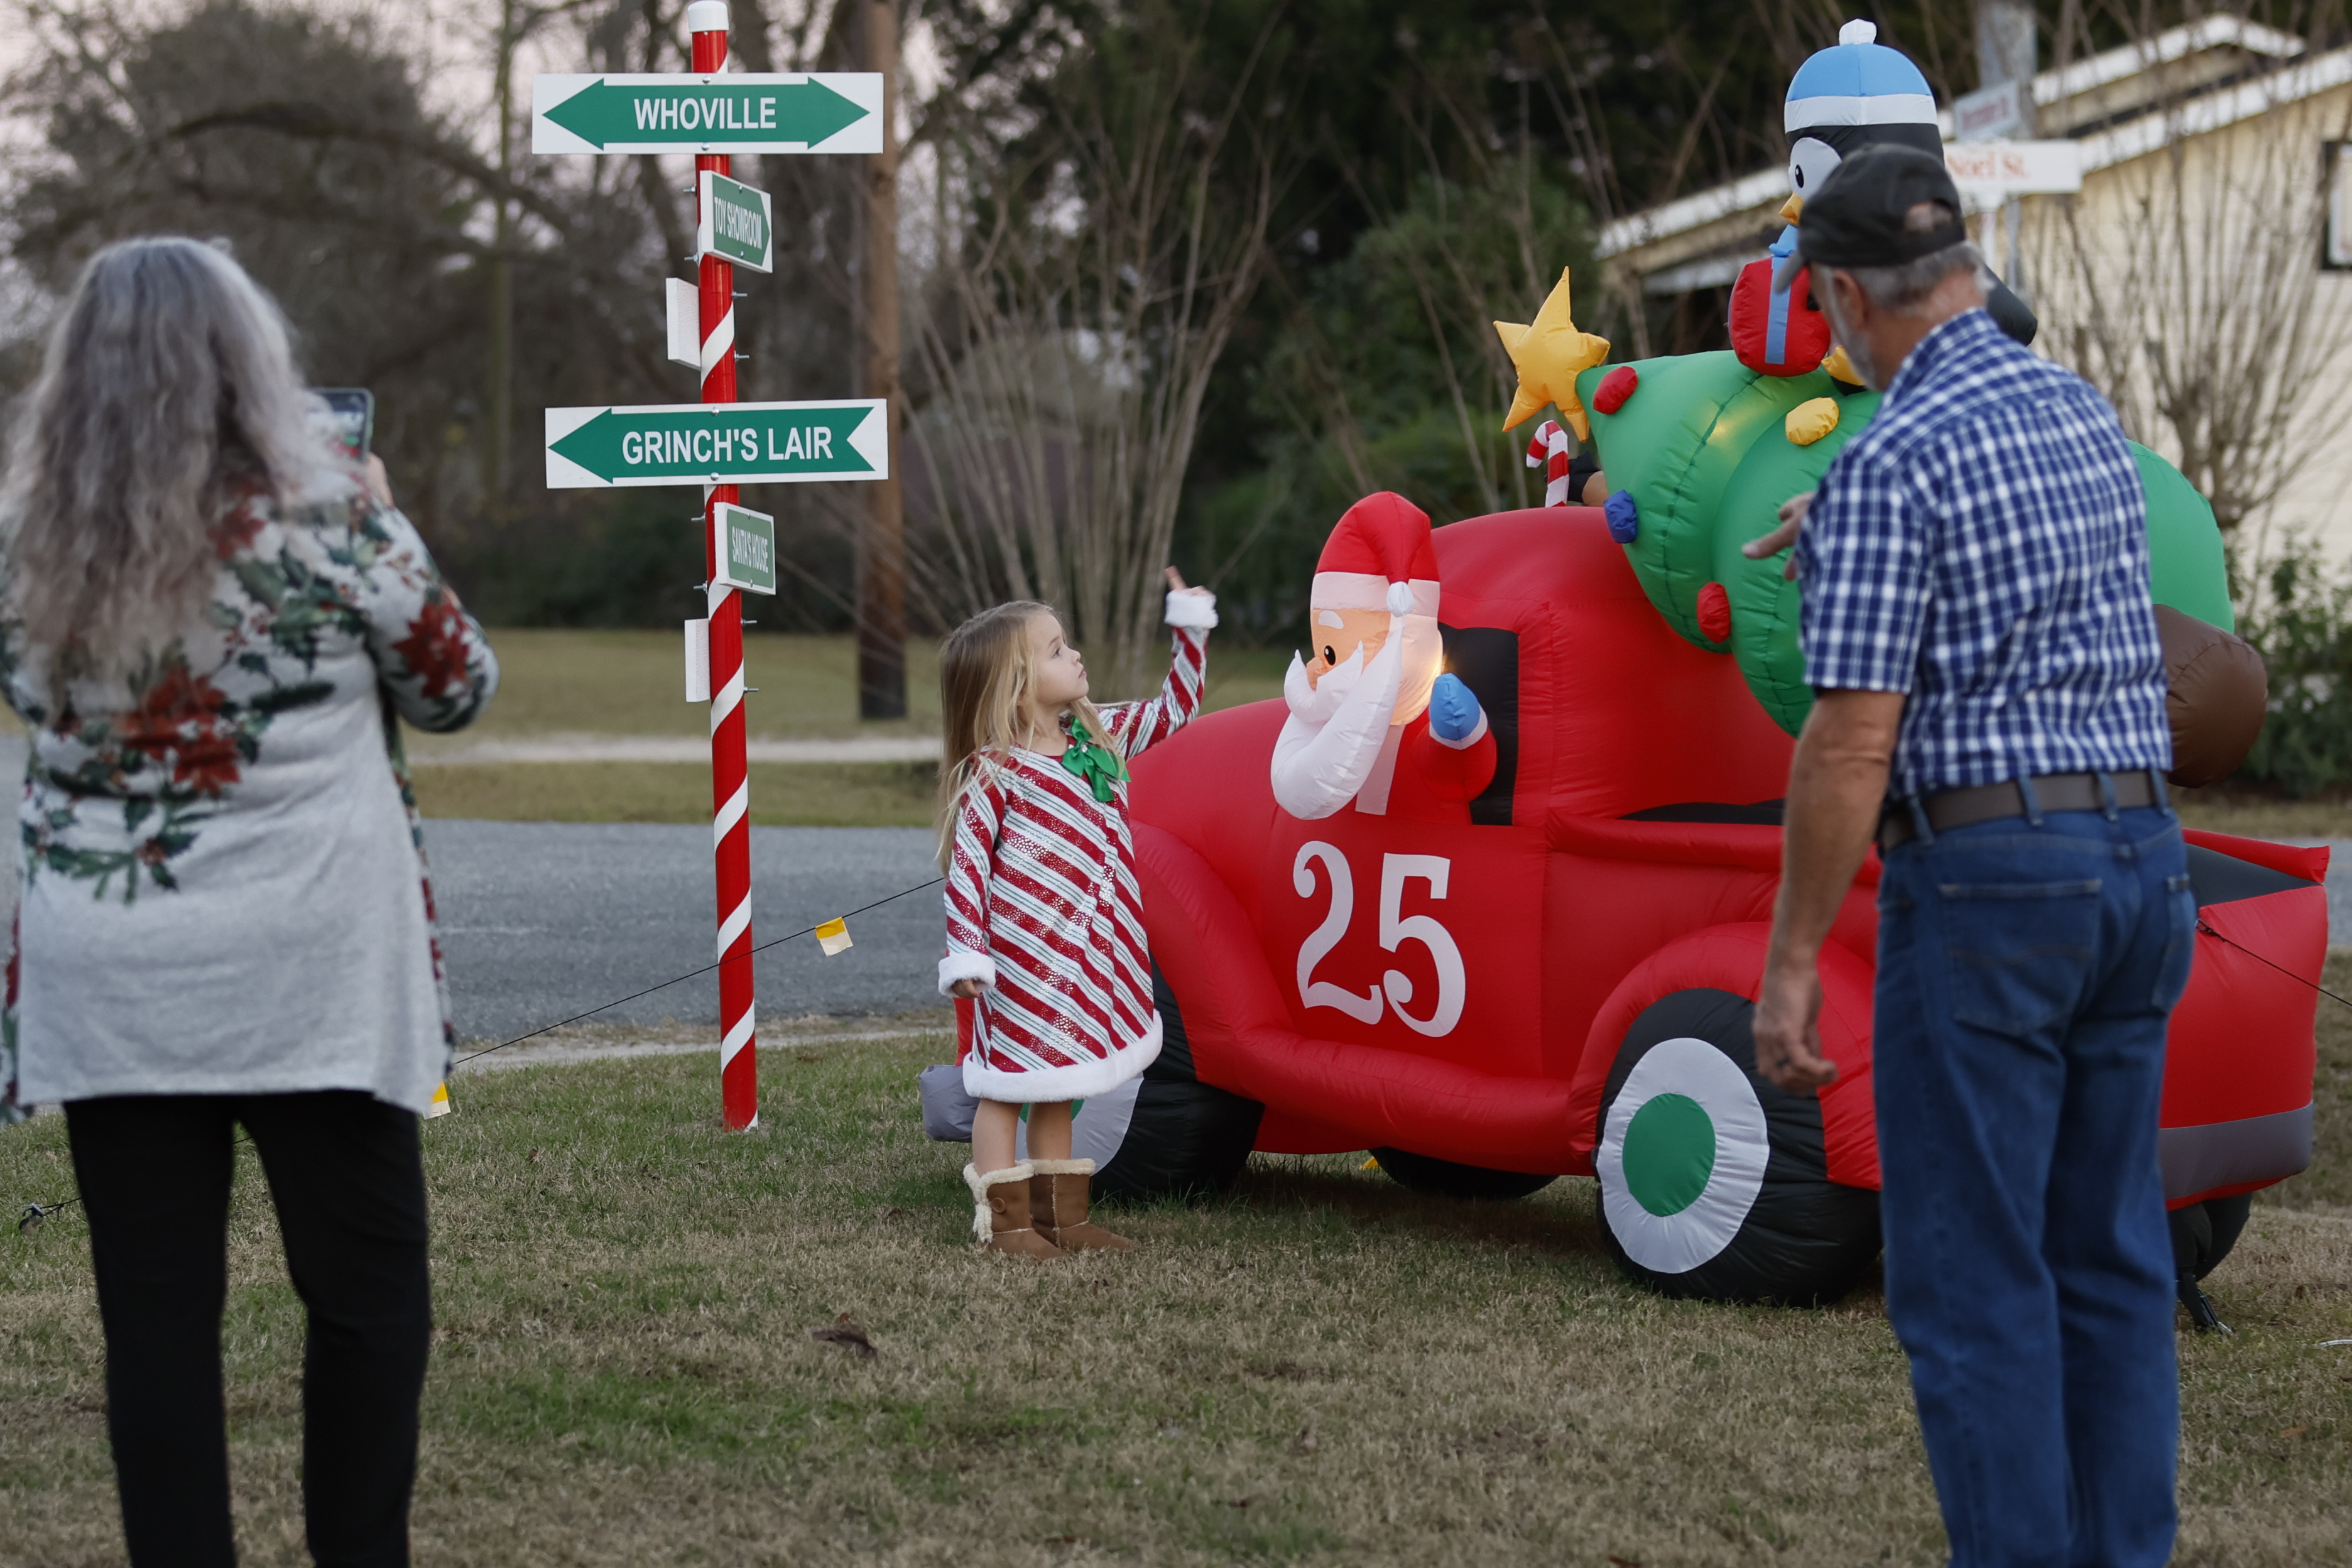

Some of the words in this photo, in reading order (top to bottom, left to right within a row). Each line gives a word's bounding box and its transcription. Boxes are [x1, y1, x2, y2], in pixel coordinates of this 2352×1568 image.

[634, 97, 776, 130] WHOVILLE
[714, 196, 727, 236] TOY
[727, 201, 762, 249] SHOWROOM
[622, 428, 759, 464] GRINCH'S
[768, 427, 834, 460] LAIR
[732, 526, 752, 567] SANTA'S
[752, 533, 769, 574] HOUSE
[1293, 841, 1466, 1038] 25
